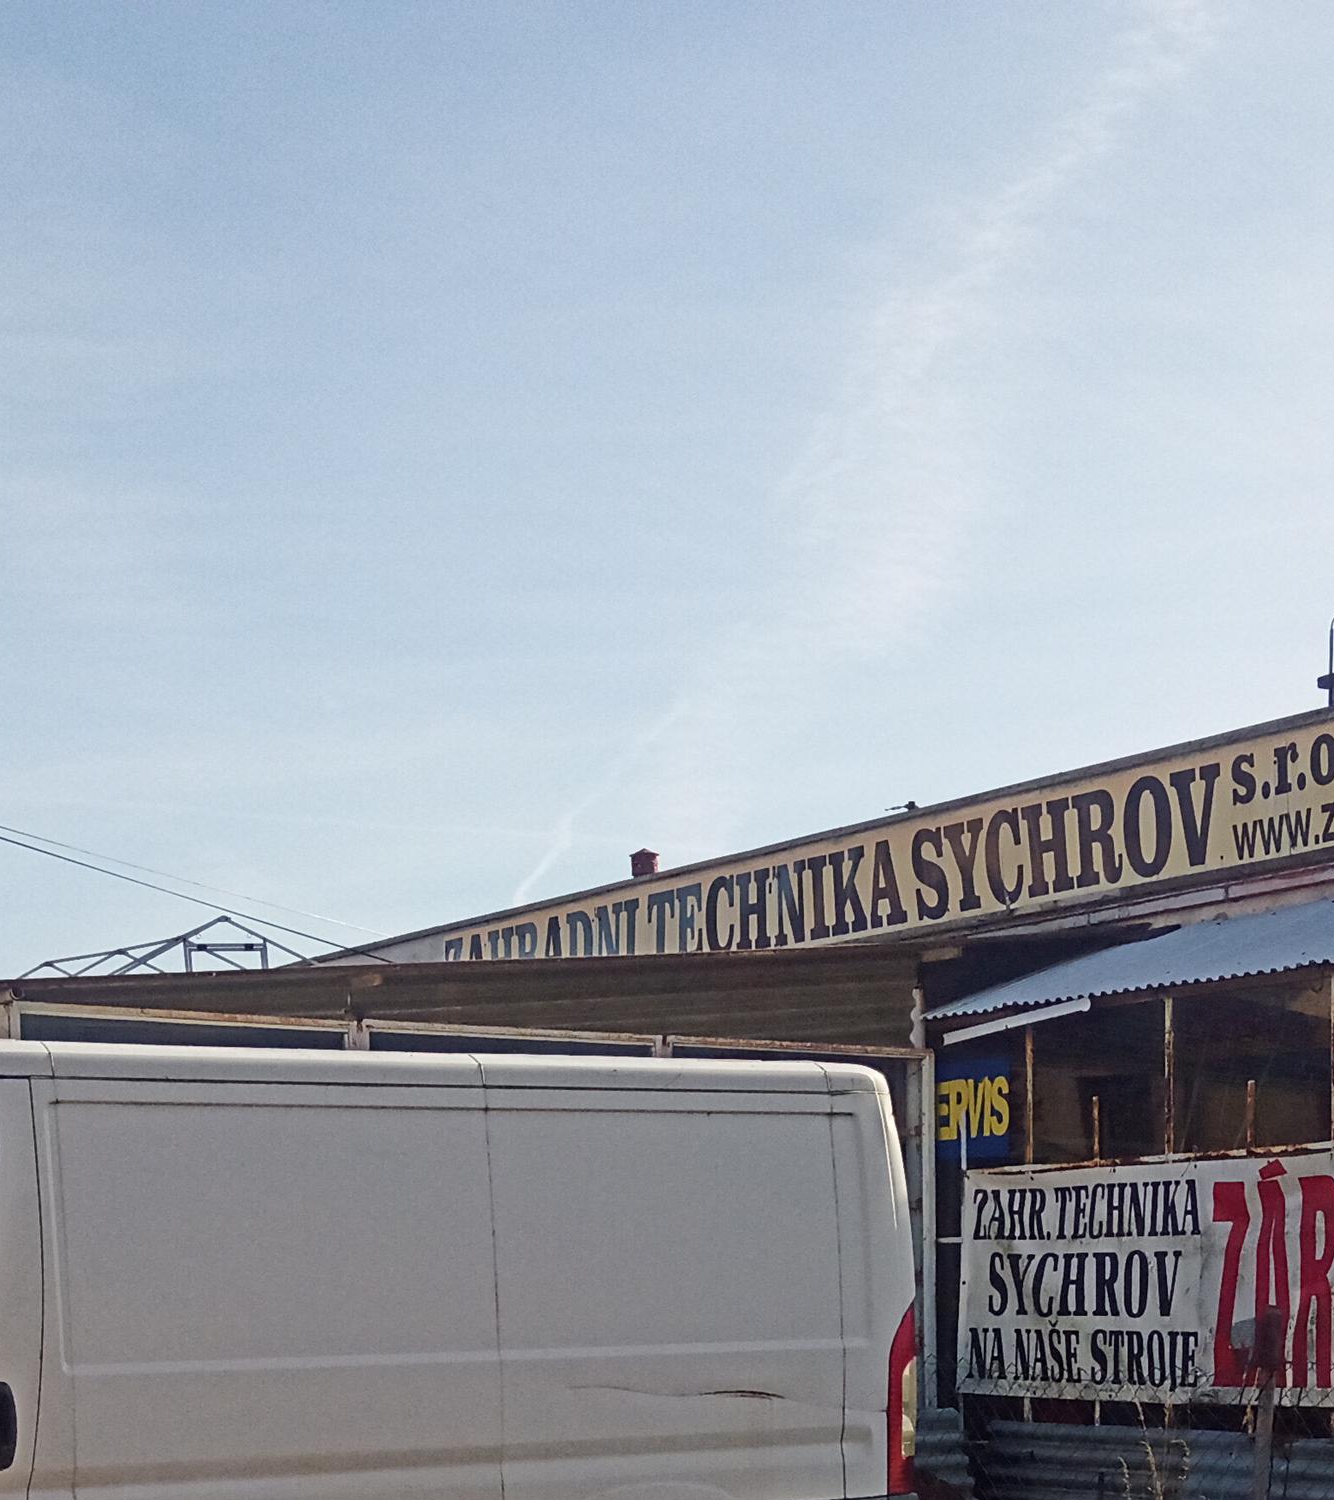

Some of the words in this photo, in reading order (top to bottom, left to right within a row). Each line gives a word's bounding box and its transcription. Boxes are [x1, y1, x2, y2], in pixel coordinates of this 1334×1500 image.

[647, 839, 908, 954] TECHNIKA
[911, 763, 1221, 921] SYCHROV
[988, 1250, 1182, 1318] SYCHROV
[966, 1327, 1008, 1380] NA
[1013, 1319, 1082, 1384] NAŠE
[1090, 1329, 1199, 1392] STROJE
